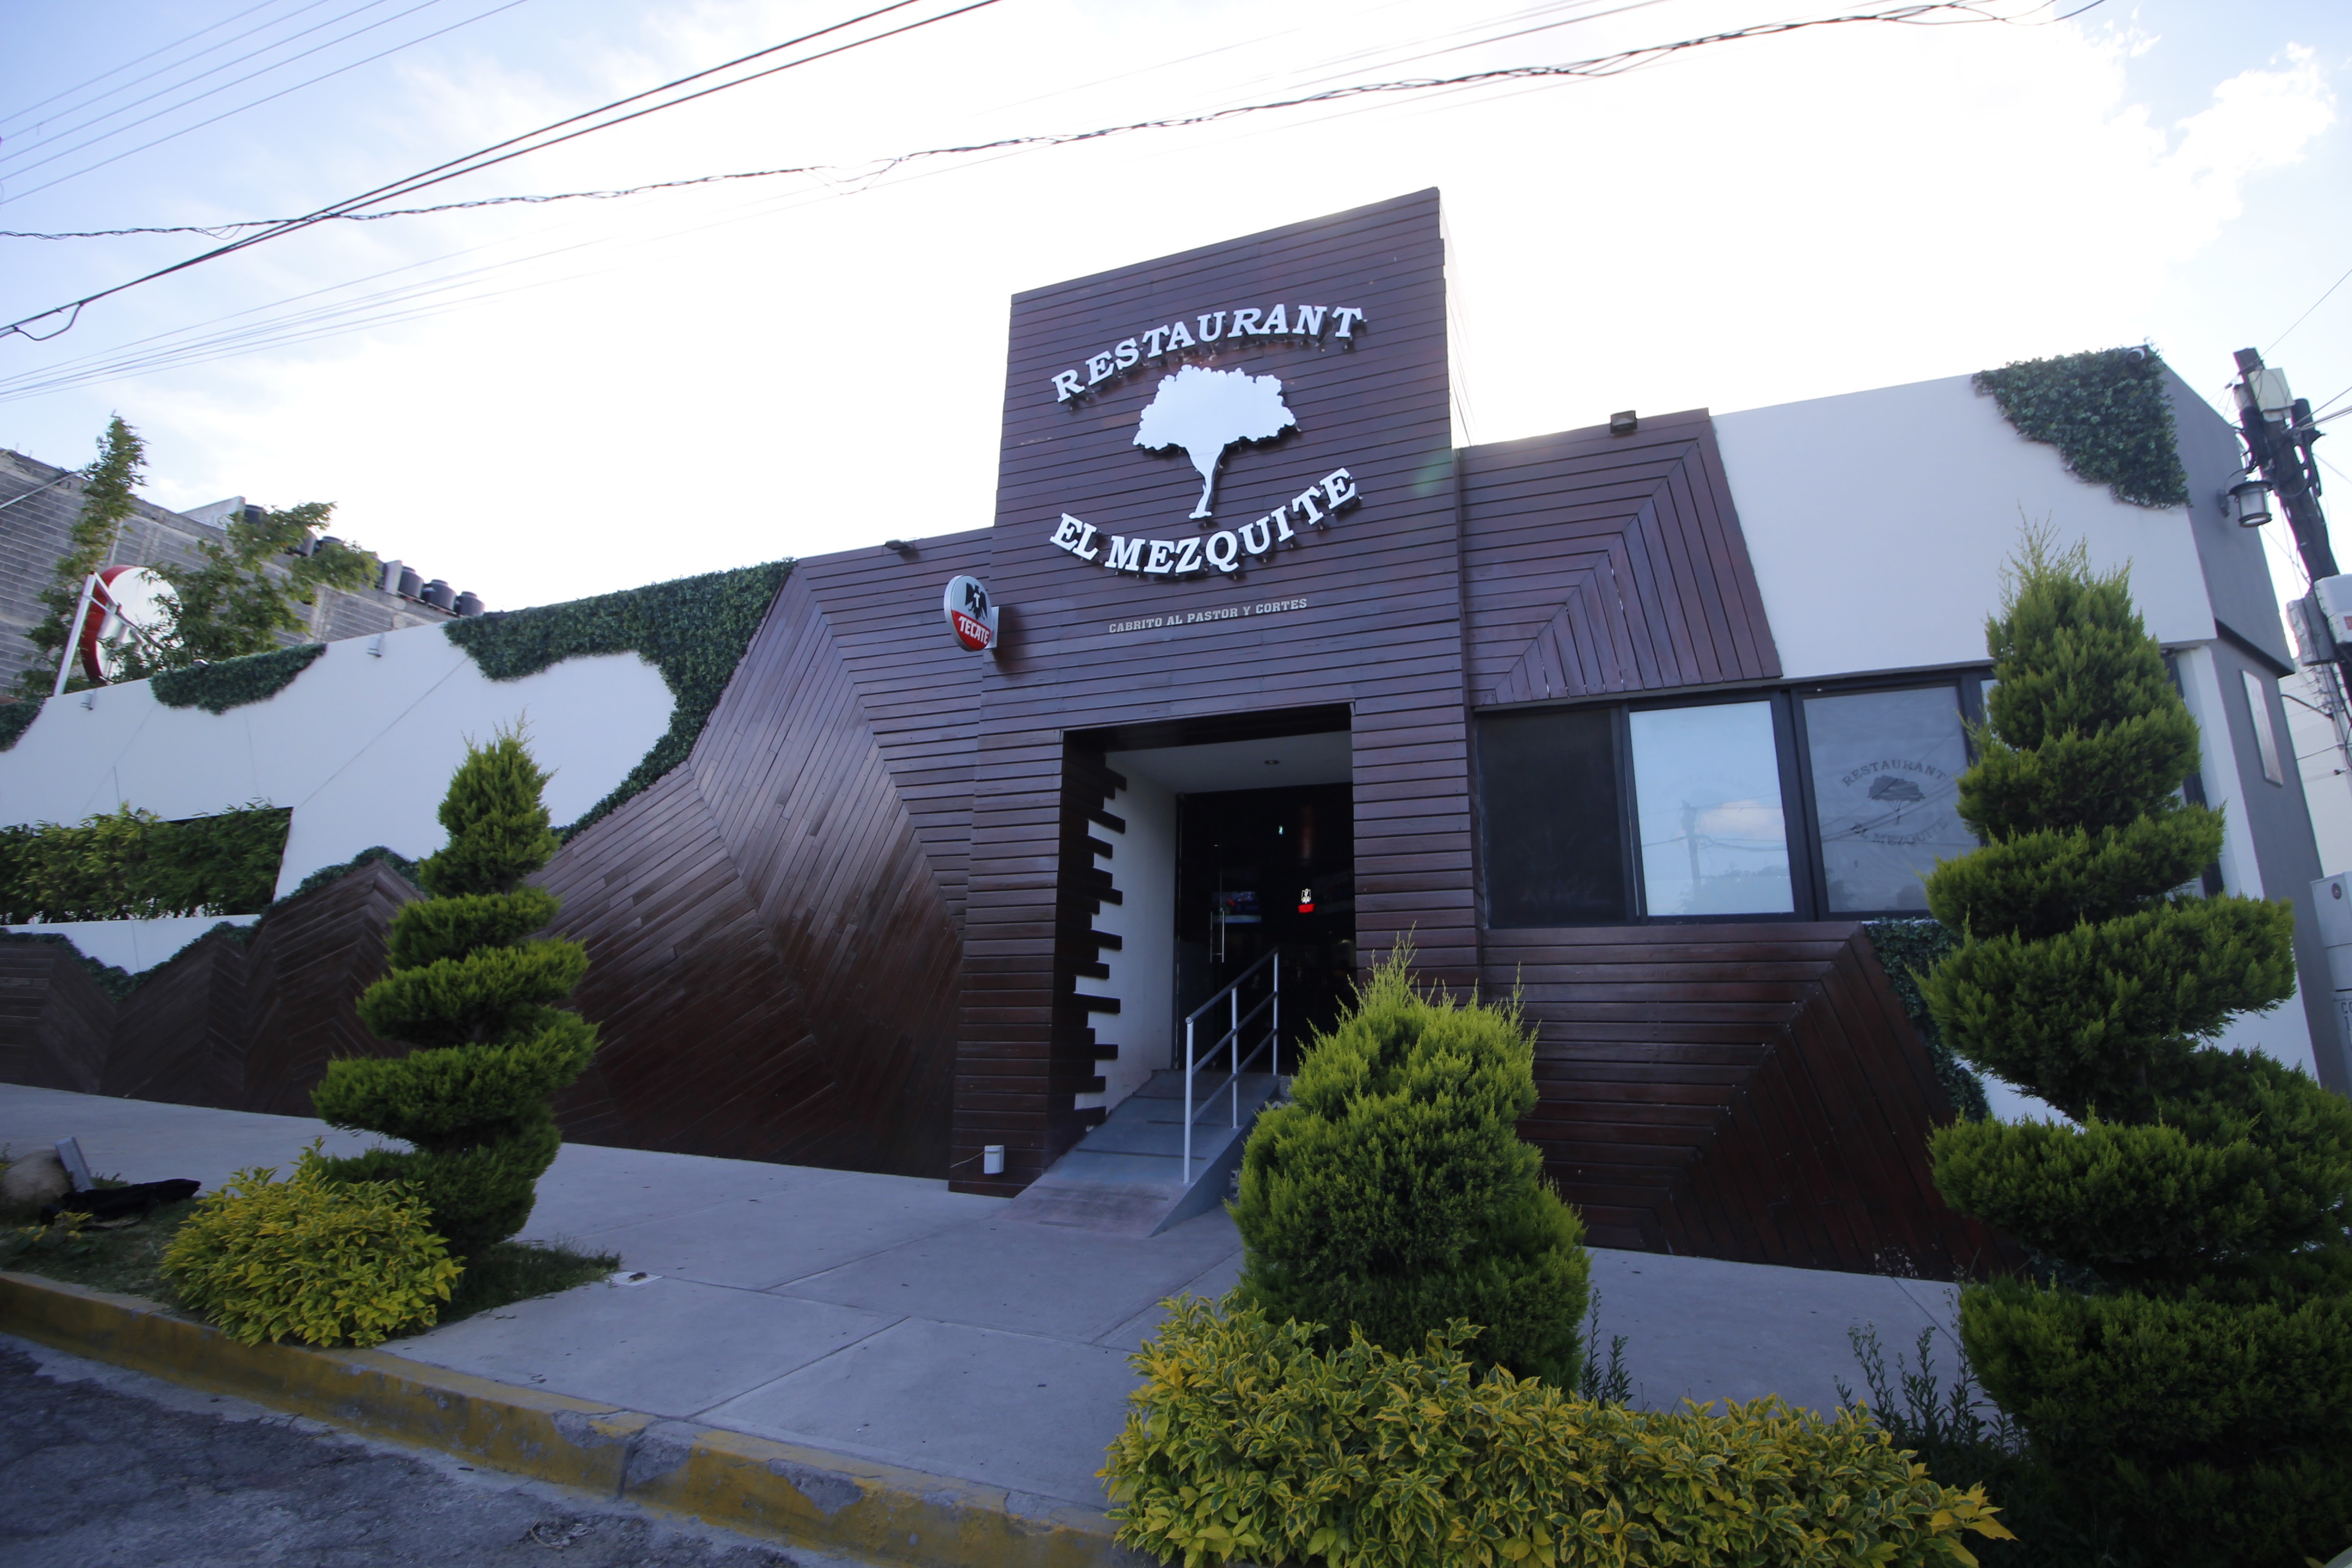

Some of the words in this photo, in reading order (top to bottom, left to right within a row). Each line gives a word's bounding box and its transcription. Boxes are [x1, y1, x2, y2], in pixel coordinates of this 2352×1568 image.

[1052, 303, 1363, 402] RESTAURANT
[1050, 512, 1099, 561] EL
[1104, 467, 1356, 574] MEZQUITE
[958, 616, 989, 644] TECATE
[1109, 617, 1162, 634] CABRITO
[1167, 614, 1182, 626] AL
[1187, 607, 1238, 623] PASTOR
[1243, 606, 1250, 615] Y
[1256, 598, 1307, 614] CORTES
[1842, 760, 1946, 786] RESTAURANT
